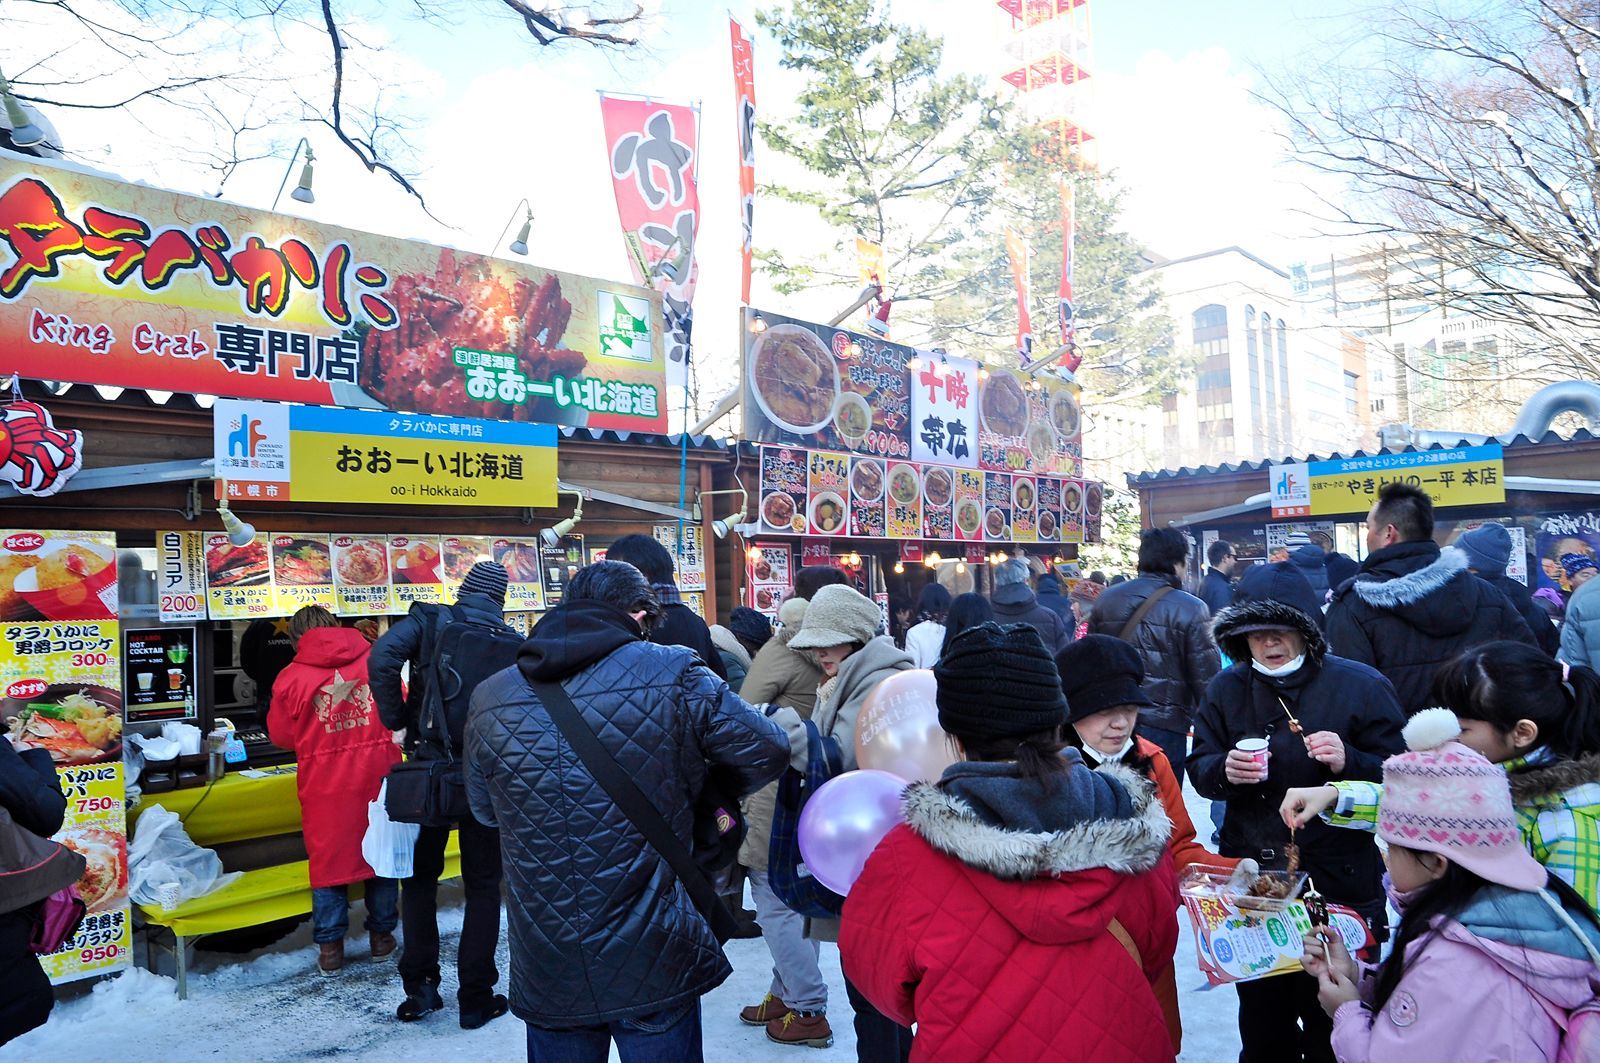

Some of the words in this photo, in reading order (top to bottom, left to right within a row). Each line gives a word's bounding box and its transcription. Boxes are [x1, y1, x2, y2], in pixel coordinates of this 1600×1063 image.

[0, 178, 397, 327] タラバかに
[31, 310, 113, 353] King
[133, 323, 207, 356] Crab
[214, 324, 360, 383] 専門店
[466, 365, 658, 418] おおーい北海道
[920, 360, 970, 410] 十勝
[388, 416, 485, 438] タラバかに専門店
[335, 444, 525, 481] おおーい北海道
[810, 453, 848, 478] おでん
[1462, 467, 1498, 487] 本店
[228, 483, 280, 498] 札幌市
[419, 483, 478, 498] Hokkaido
[685, 526, 696, 566] 日本酒
[164, 532, 183, 588] 白ココア
[161, 596, 197, 612] 200
[6, 625, 100, 640] タラバかに
[15, 638, 114, 656] 男爵コロッケ
[71, 652, 115, 667] 300円
[8, 683, 47, 697] おすすめ
[324, 715, 370, 734] LION
[330, 708, 361, 722] GINZA
[76, 796, 121, 813] 750円
[80, 944, 126, 964] 950円
